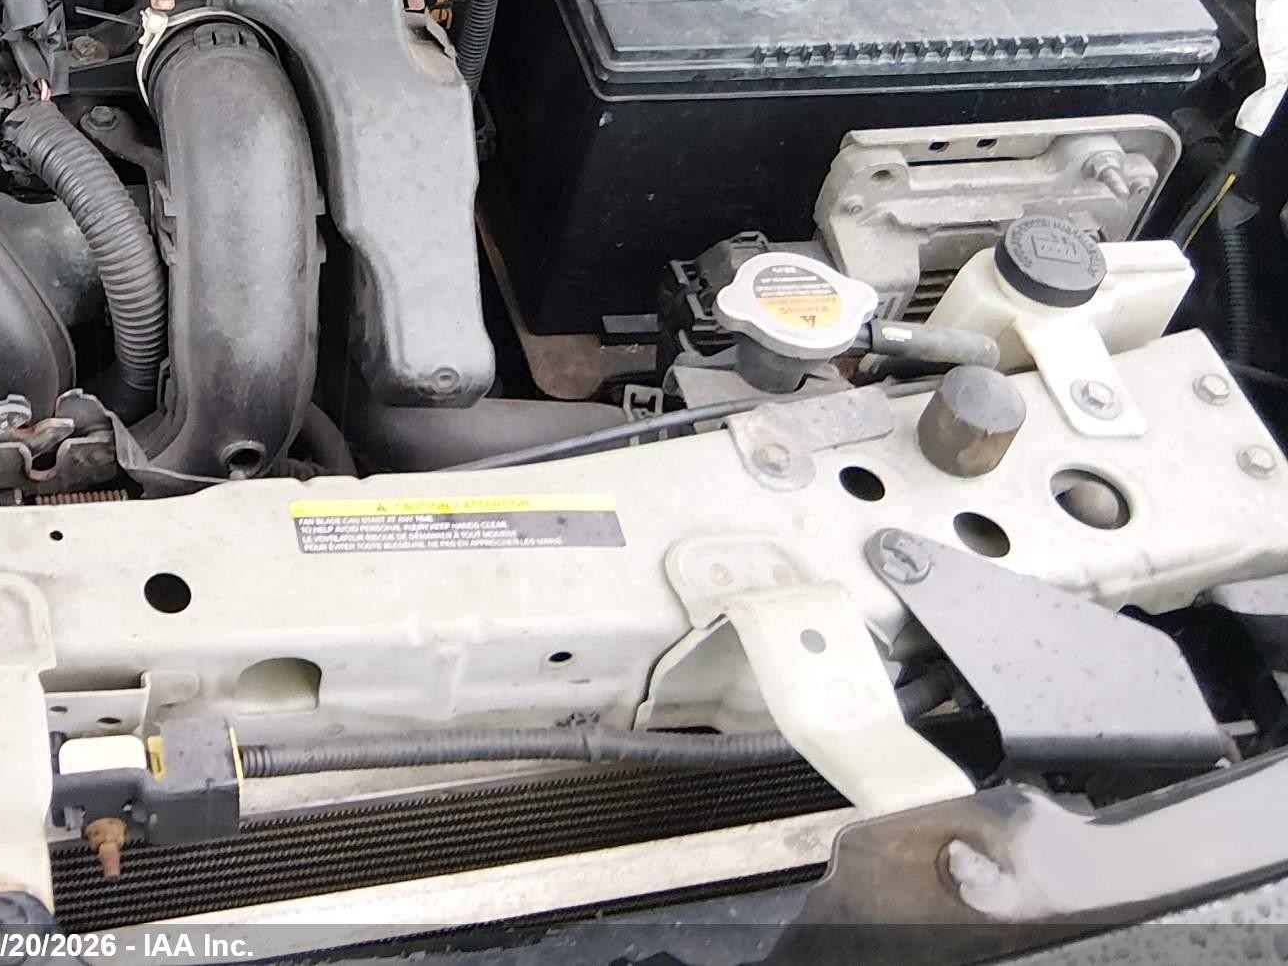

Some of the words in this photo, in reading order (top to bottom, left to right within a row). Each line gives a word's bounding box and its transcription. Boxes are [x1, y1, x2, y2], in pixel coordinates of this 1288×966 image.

[312, 525, 334, 534] HELP
[334, 525, 359, 533] AVOID
[359, 524, 402, 533] PERSONAL
[429, 522, 451, 531] KEEP
[451, 521, 479, 530] HANDS
